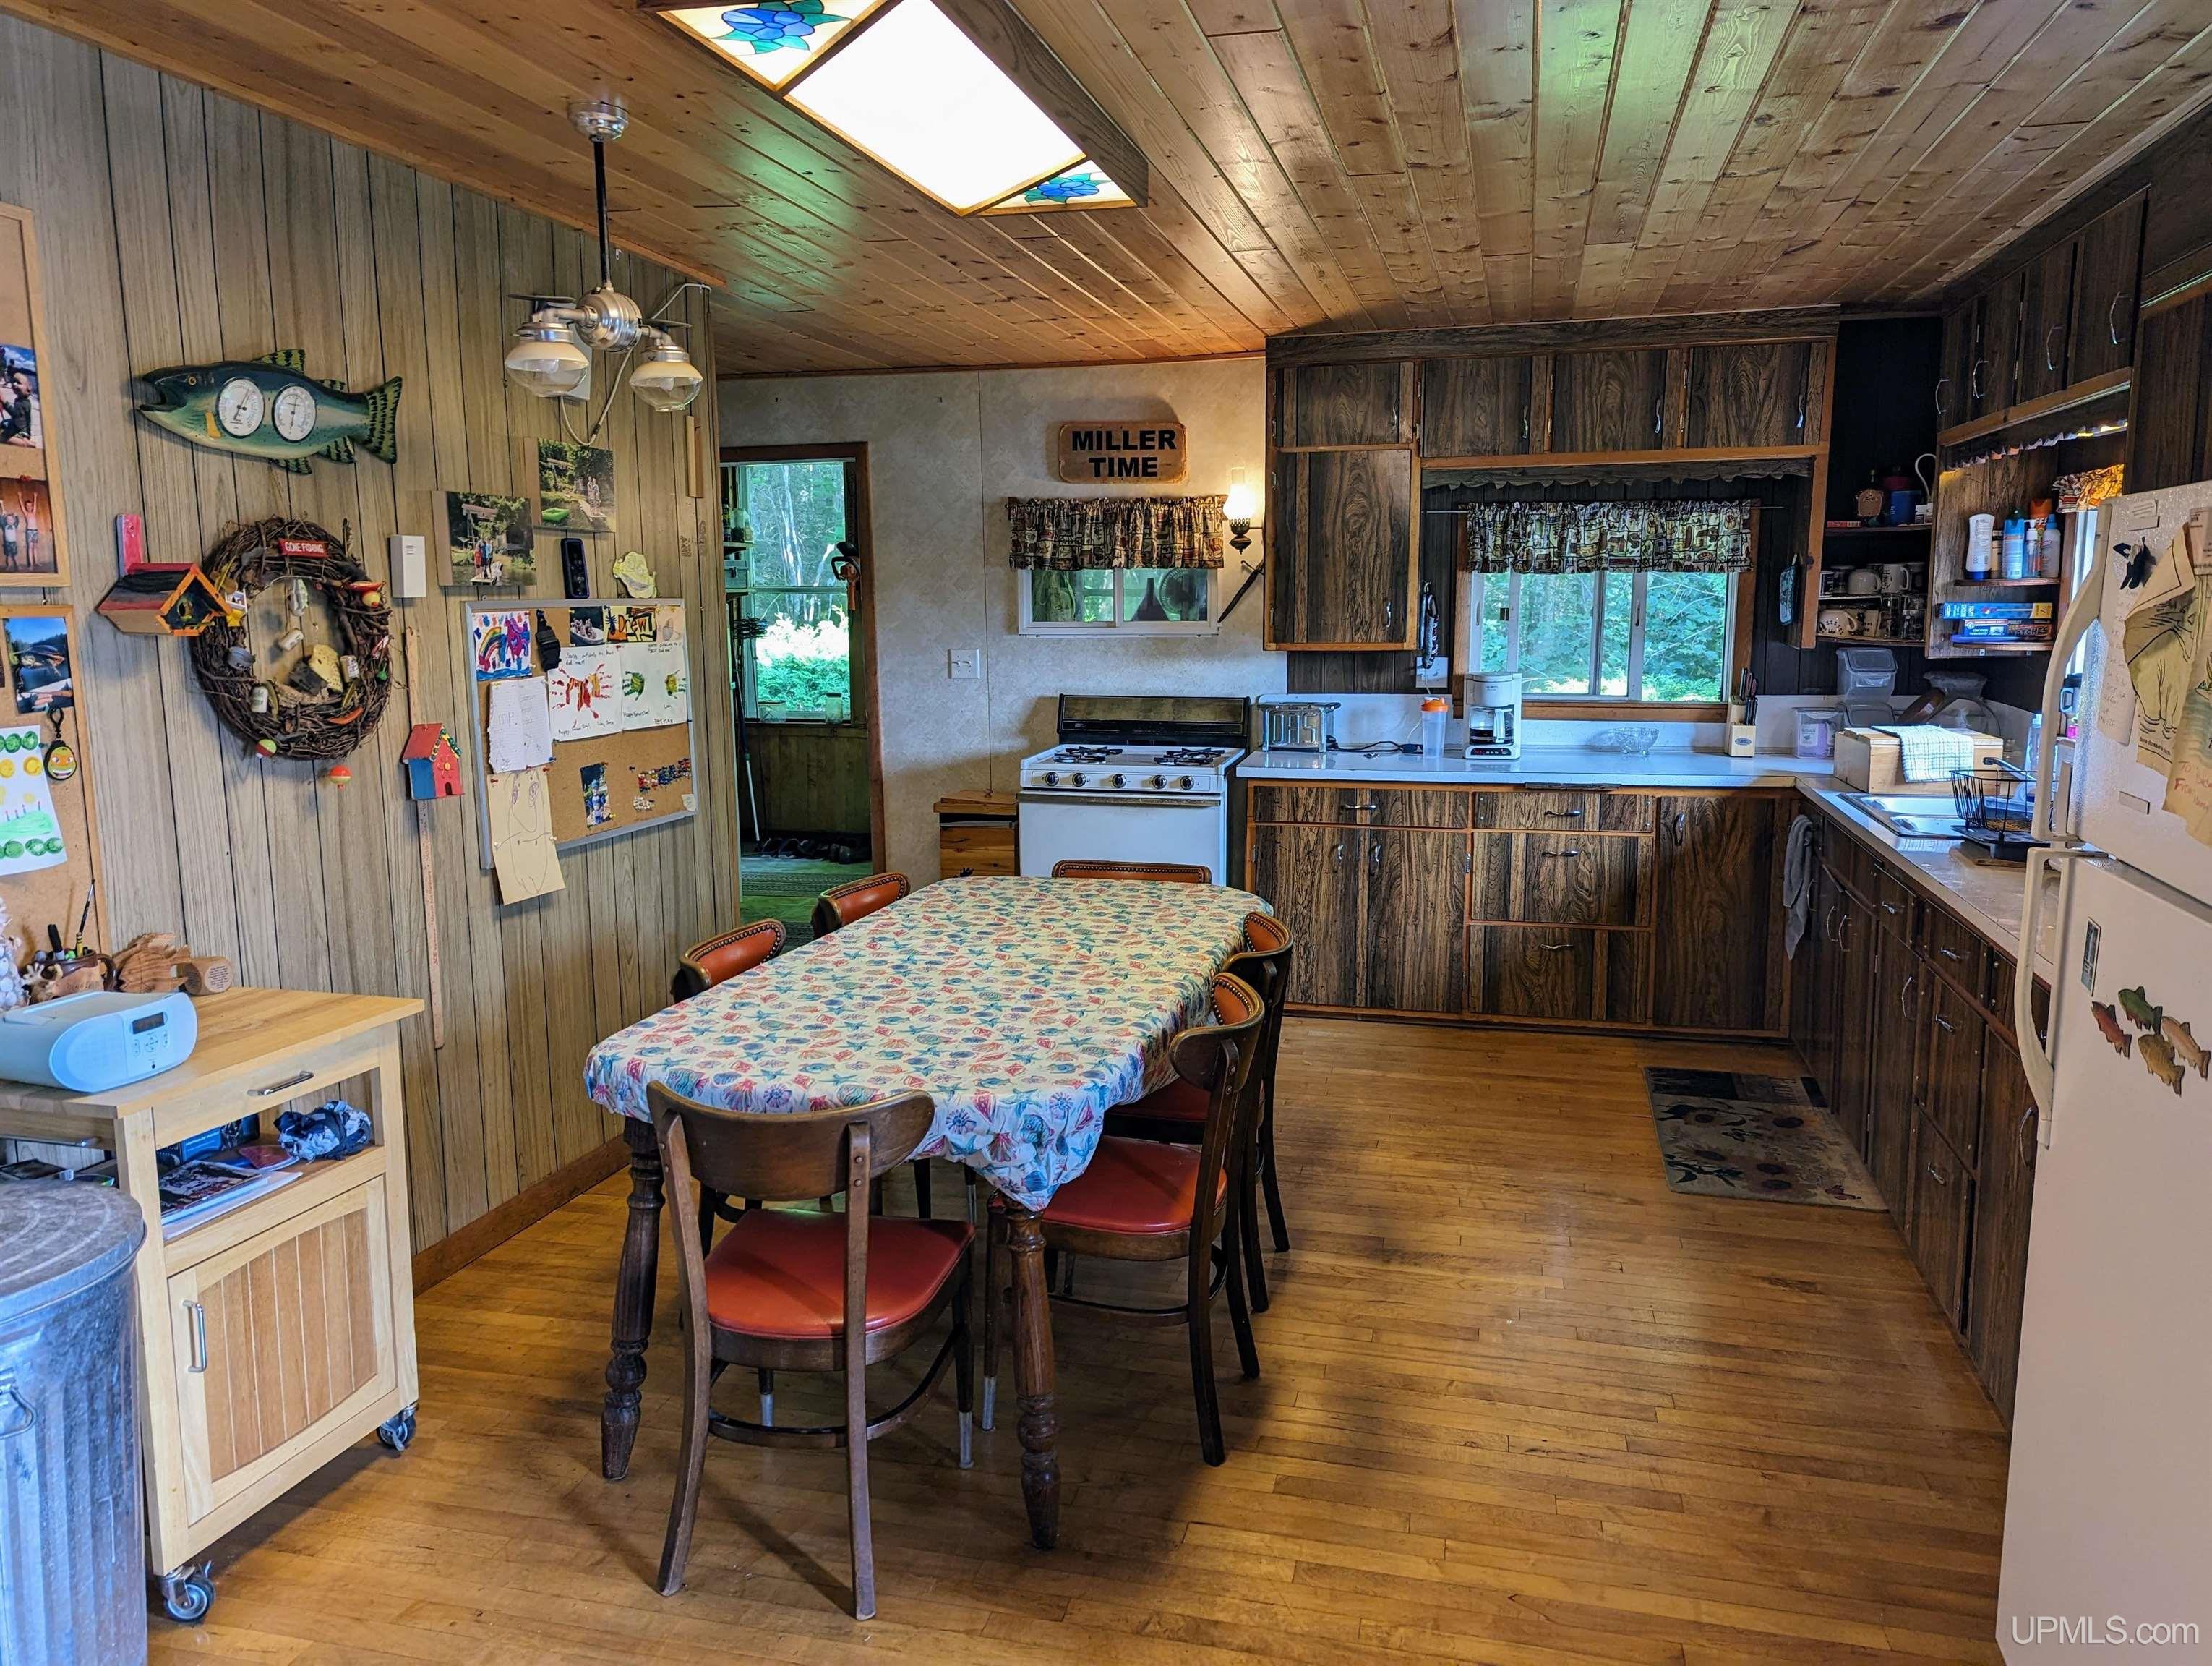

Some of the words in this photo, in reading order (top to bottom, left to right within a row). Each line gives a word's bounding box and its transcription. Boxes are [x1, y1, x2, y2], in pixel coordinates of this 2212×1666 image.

[1072, 430, 1177, 451] MILLER
[1088, 456, 1158, 477] TIME
[284, 541, 302, 552] GONE
[301, 542, 325, 553] FISHING
[617, 614, 648, 633] Drew
